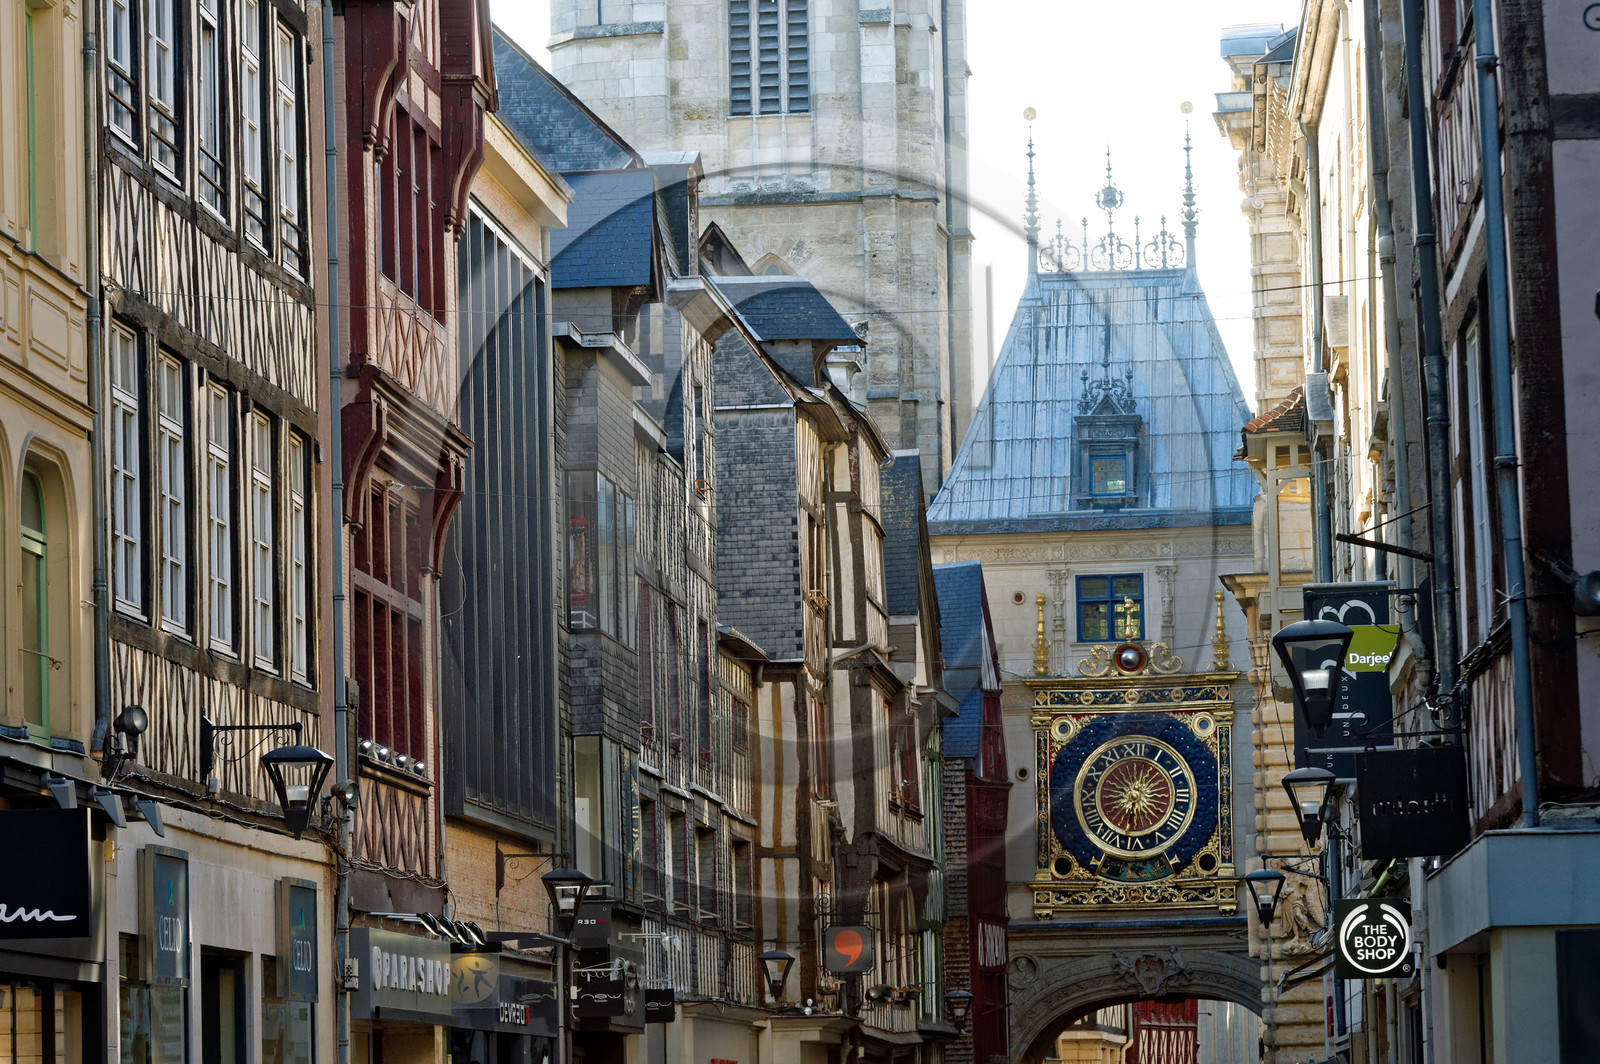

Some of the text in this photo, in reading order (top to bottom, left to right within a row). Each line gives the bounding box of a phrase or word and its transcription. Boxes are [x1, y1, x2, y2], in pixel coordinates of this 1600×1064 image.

[1341, 676, 1350, 736] UN DEUX
[159, 915, 182, 953] CELIO
[1354, 935, 1398, 948] BODY
[1362, 924, 1388, 935] THE
[293, 938, 312, 972] CELIO
[1357, 948, 1396, 960] SHOP
[382, 951, 450, 997] PARASHOP
